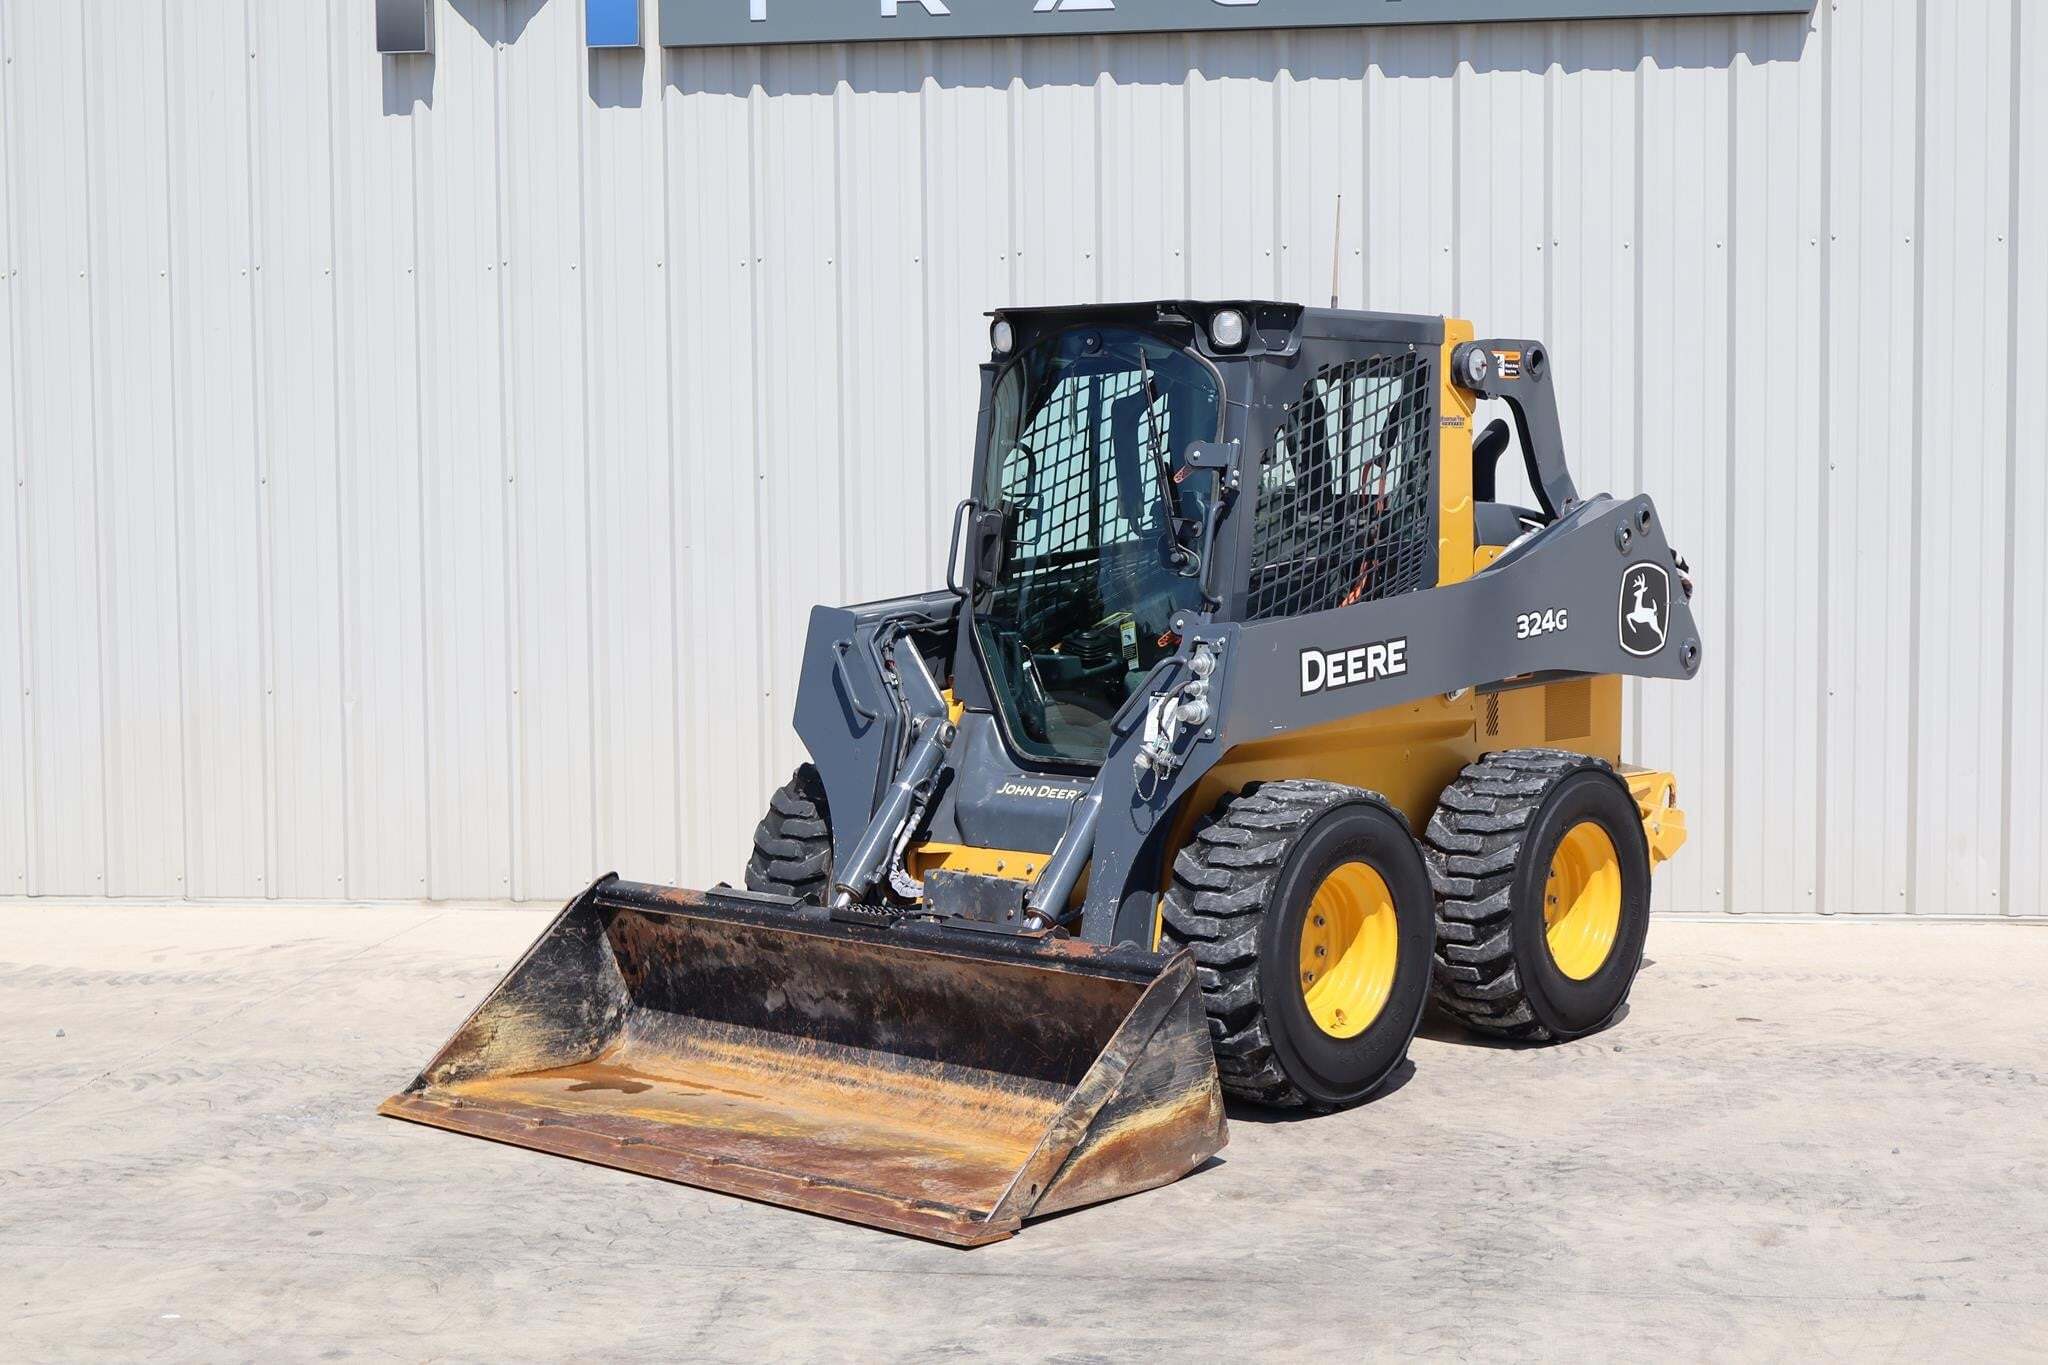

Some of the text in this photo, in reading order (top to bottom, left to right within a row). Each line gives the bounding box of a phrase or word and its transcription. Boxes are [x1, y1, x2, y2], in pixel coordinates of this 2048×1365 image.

[1516, 609, 1568, 639] 324G
[1300, 639, 1406, 693] DEERE
[995, 782, 1037, 797] JOHN
